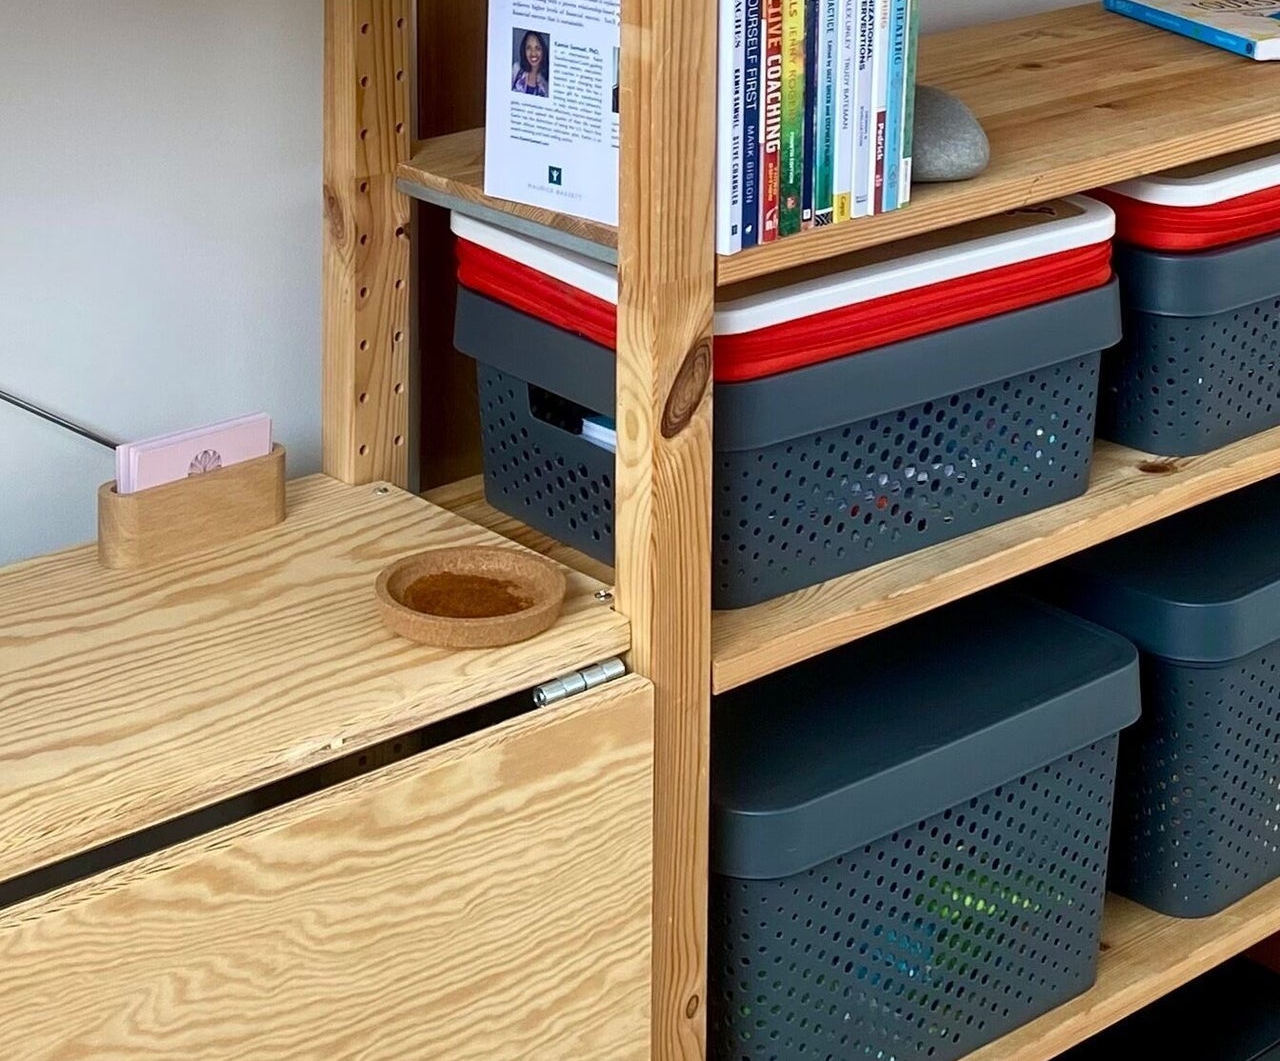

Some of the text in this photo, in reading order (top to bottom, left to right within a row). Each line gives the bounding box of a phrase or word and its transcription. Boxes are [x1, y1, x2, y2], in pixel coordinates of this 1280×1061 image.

[789, 26, 797, 64] JENNY
[745, 67, 758, 110] FIRST
[766, 54, 782, 154] COACHING
[842, 88, 850, 130] BATEMAN
[746, 125, 754, 157] MARK
[876, 123, 884, 160] Pedrick
[746, 161, 754, 204] BISSON
